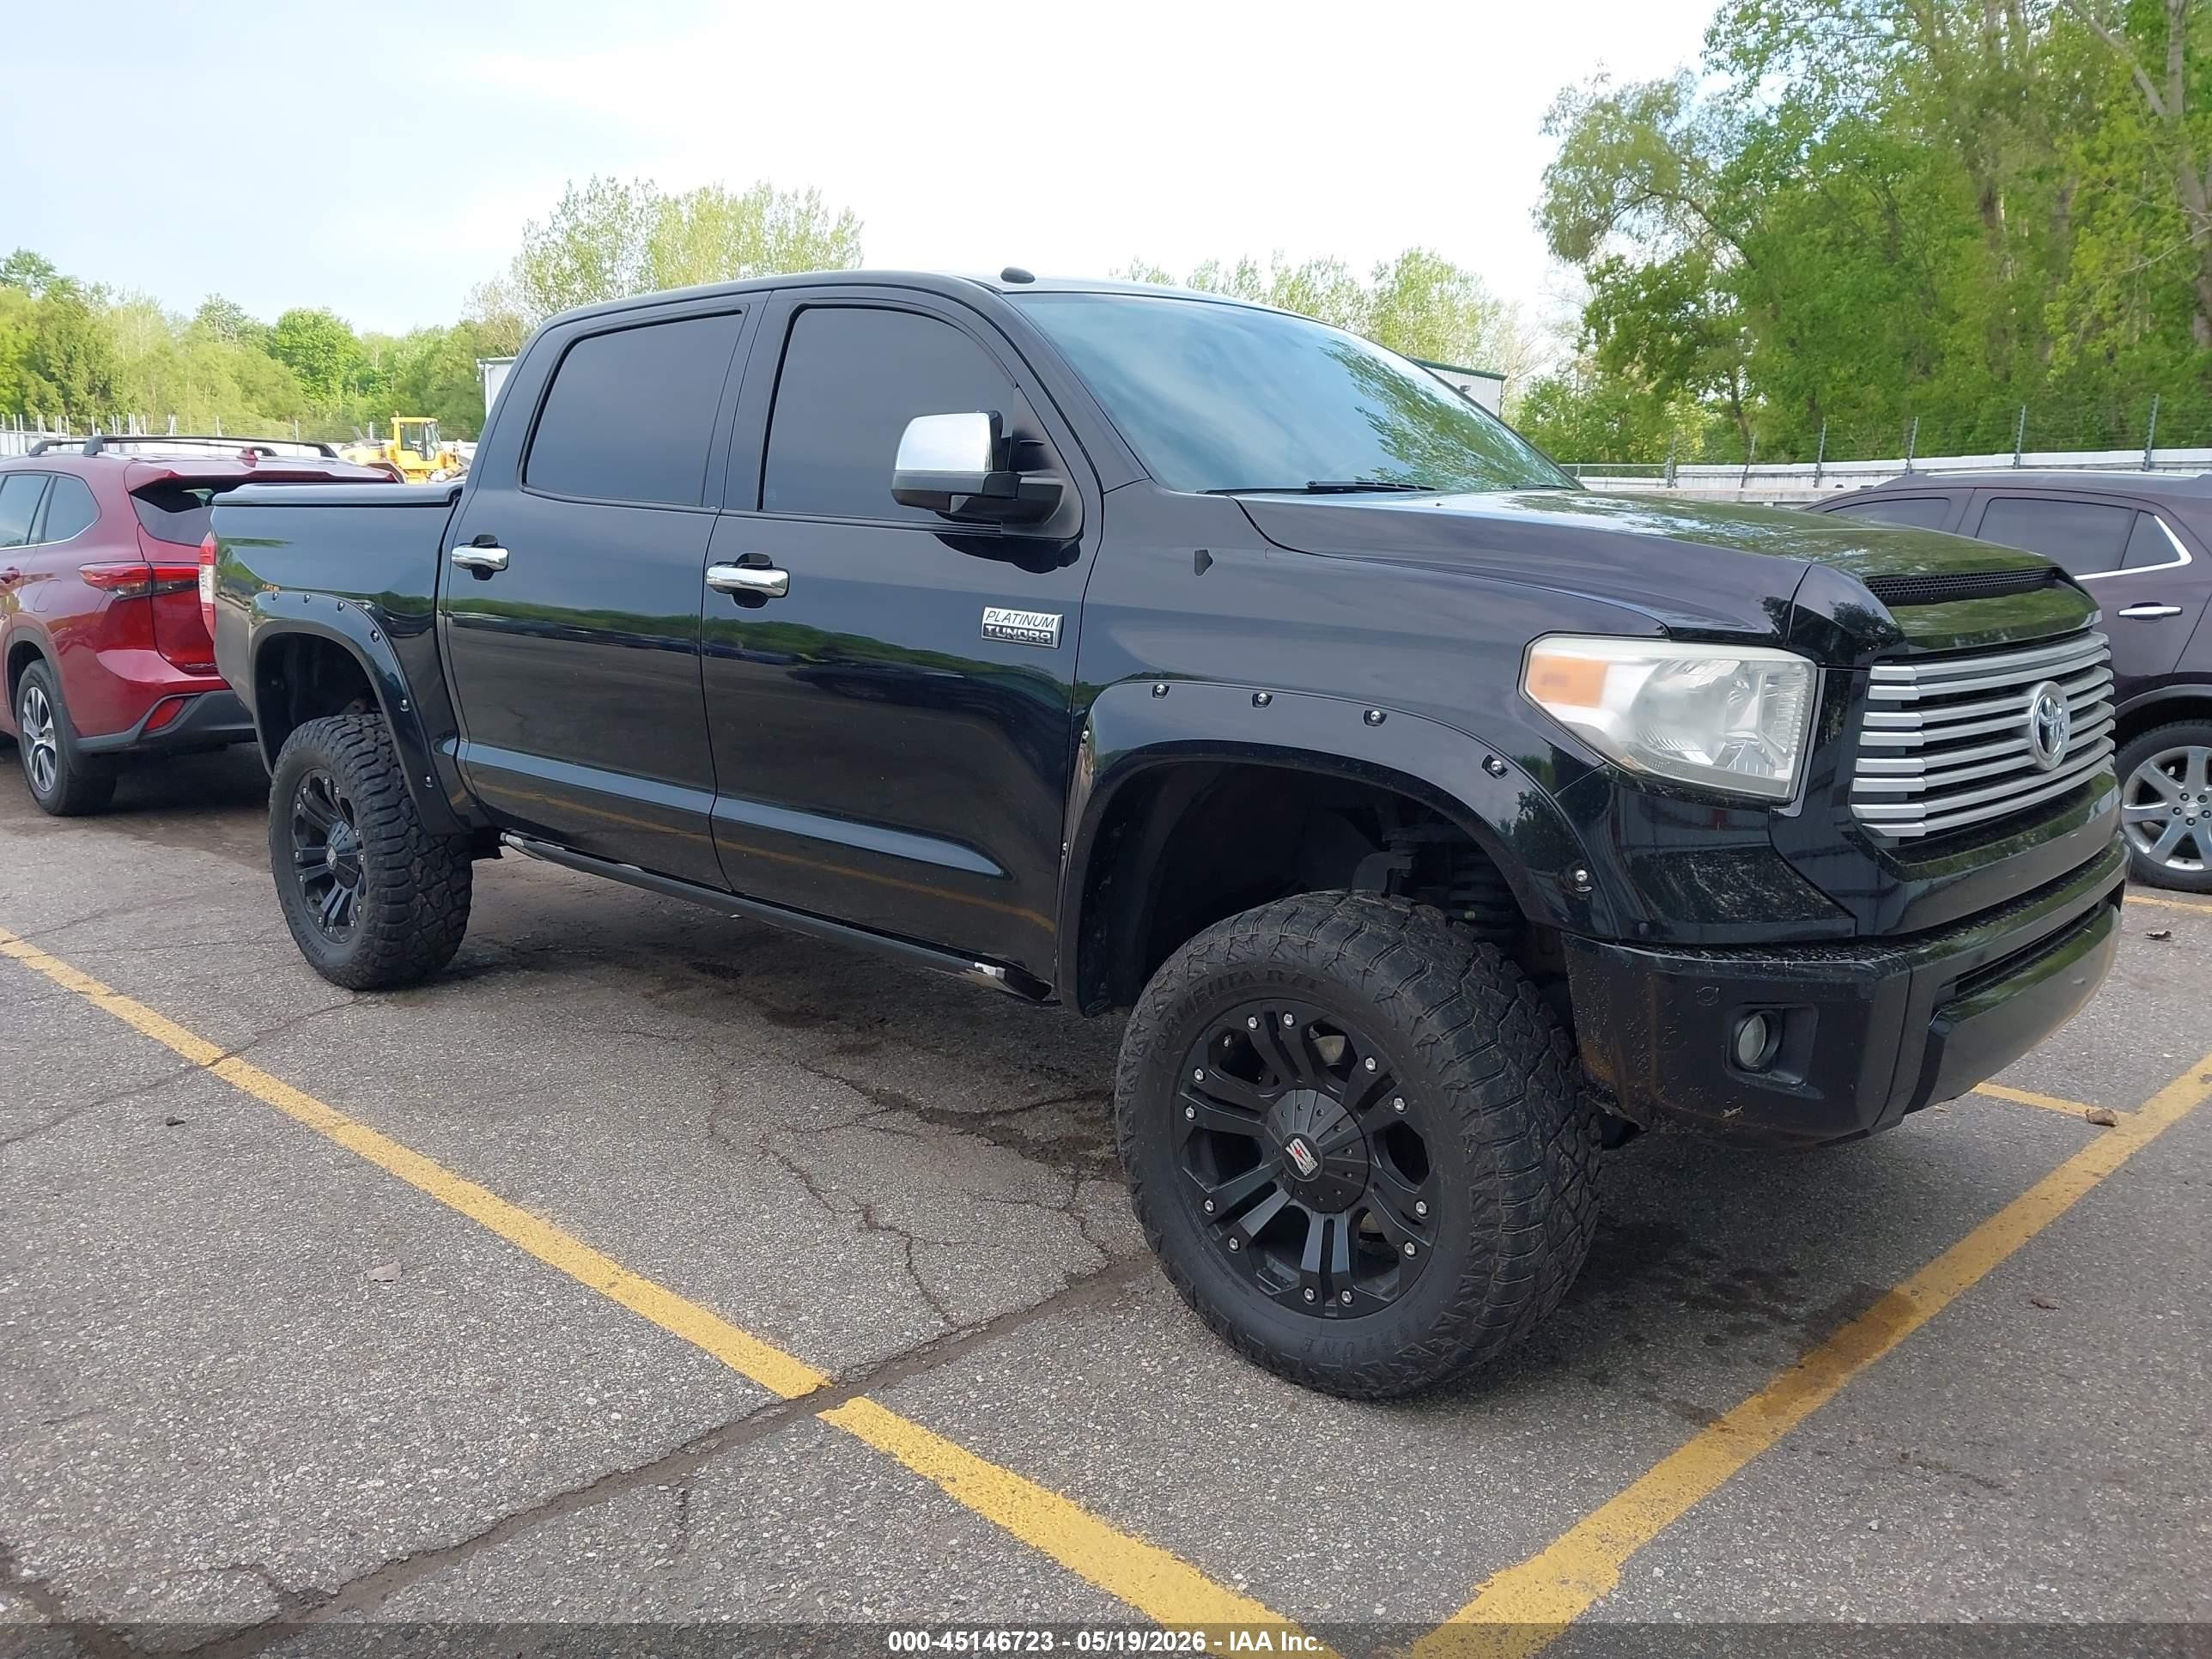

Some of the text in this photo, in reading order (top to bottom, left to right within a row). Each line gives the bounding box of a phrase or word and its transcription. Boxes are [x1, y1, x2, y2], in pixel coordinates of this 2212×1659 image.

[986, 611, 1054, 628] PLATINUM
[985, 625, 1051, 643] TUNDRA
[1285, 1139, 1311, 1173] XD
